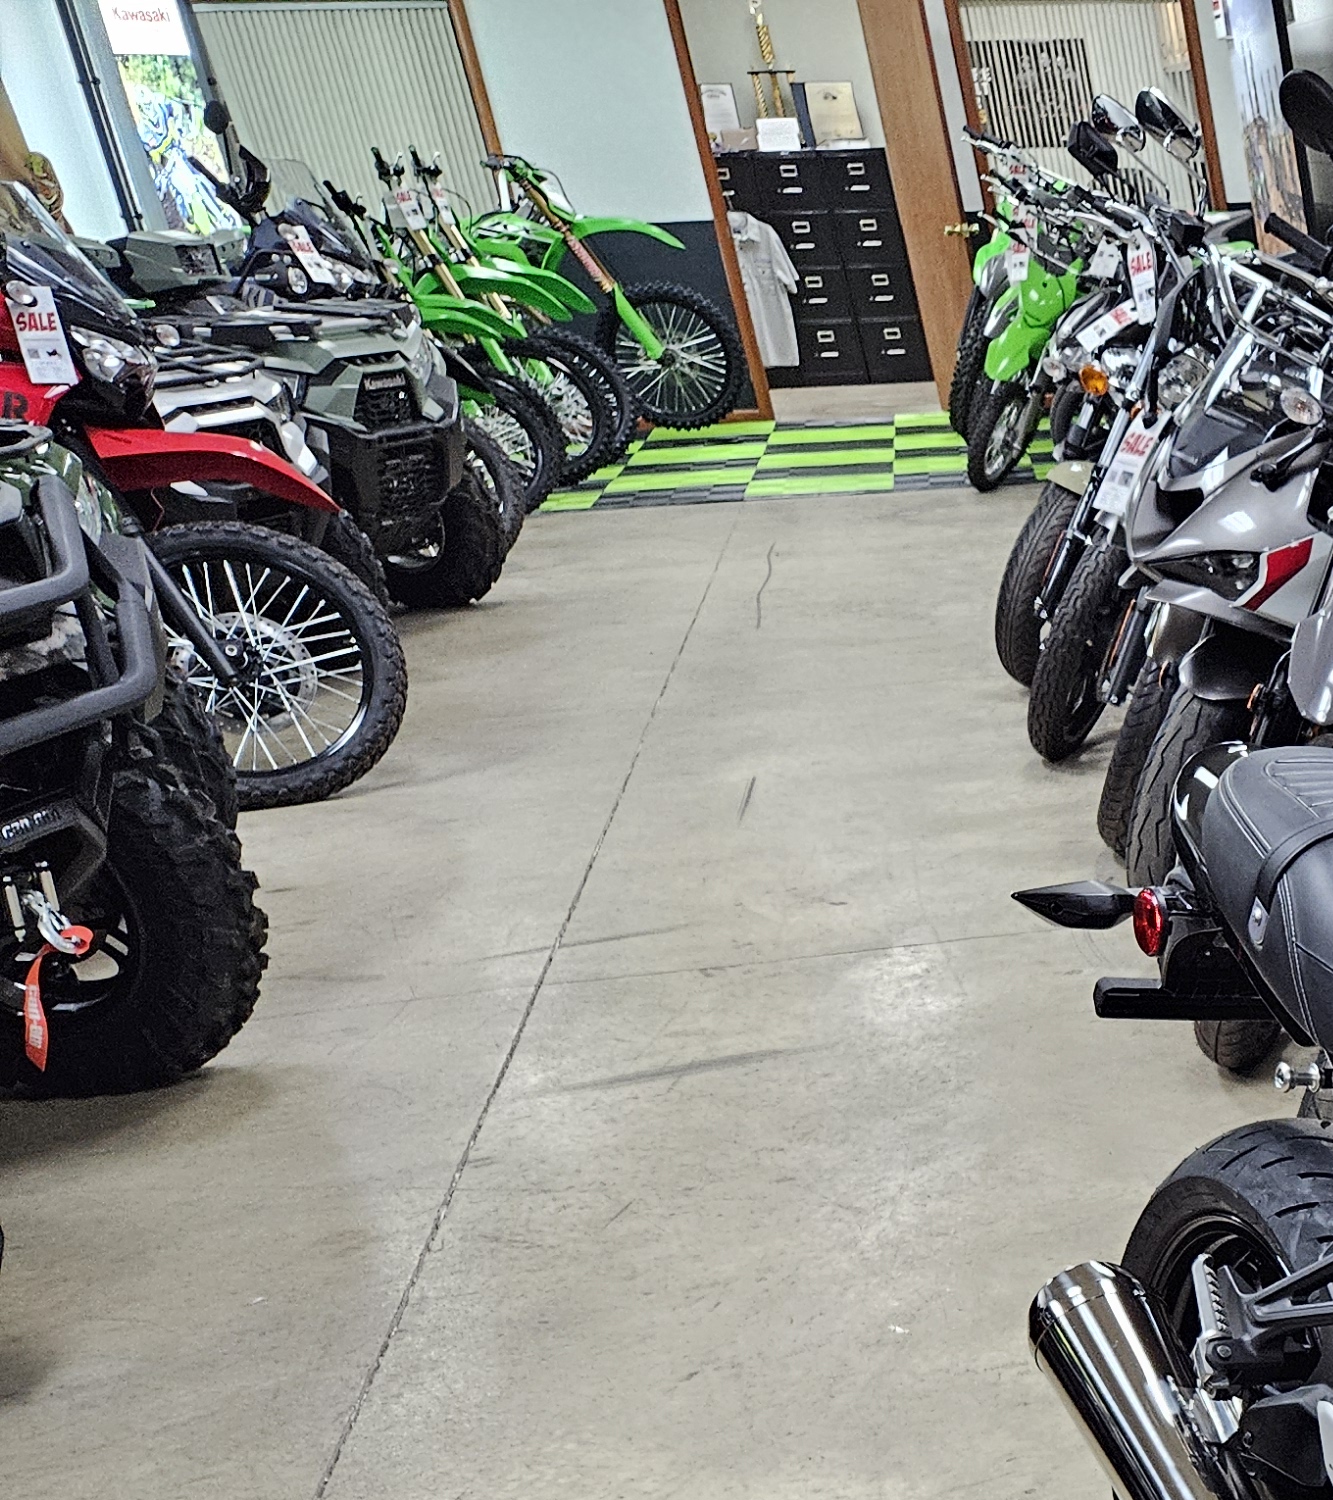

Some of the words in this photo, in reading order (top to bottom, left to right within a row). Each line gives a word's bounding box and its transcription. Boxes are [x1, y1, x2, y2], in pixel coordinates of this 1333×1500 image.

[111, 7, 170, 22] Kawasaki
[1130, 251, 1152, 276] SALE
[15, 311, 57, 332] SALE
[1120, 432, 1154, 457] SALE
